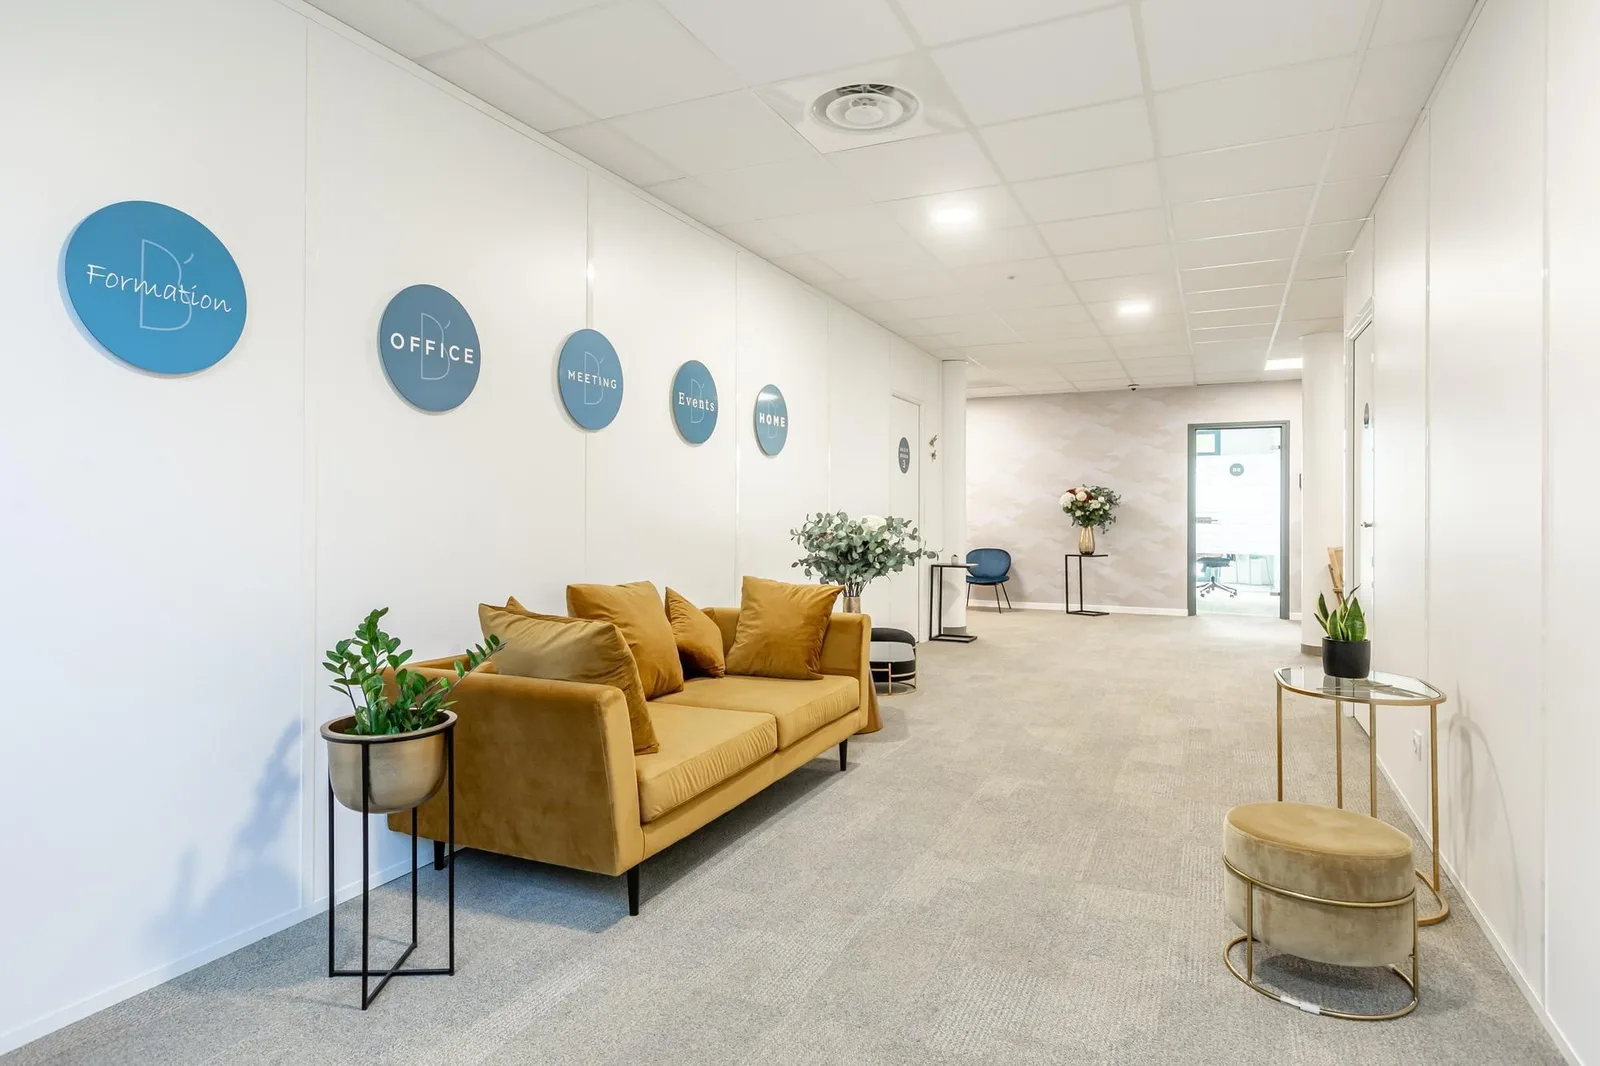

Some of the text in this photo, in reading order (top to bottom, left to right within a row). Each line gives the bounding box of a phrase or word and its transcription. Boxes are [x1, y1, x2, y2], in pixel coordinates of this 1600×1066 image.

[86, 263, 232, 313] Formation
[390, 332, 474, 364] OFFICE
[567, 369, 617, 389] MEETING
[678, 392, 715, 412] Events
[759, 412, 786, 428] HOME
